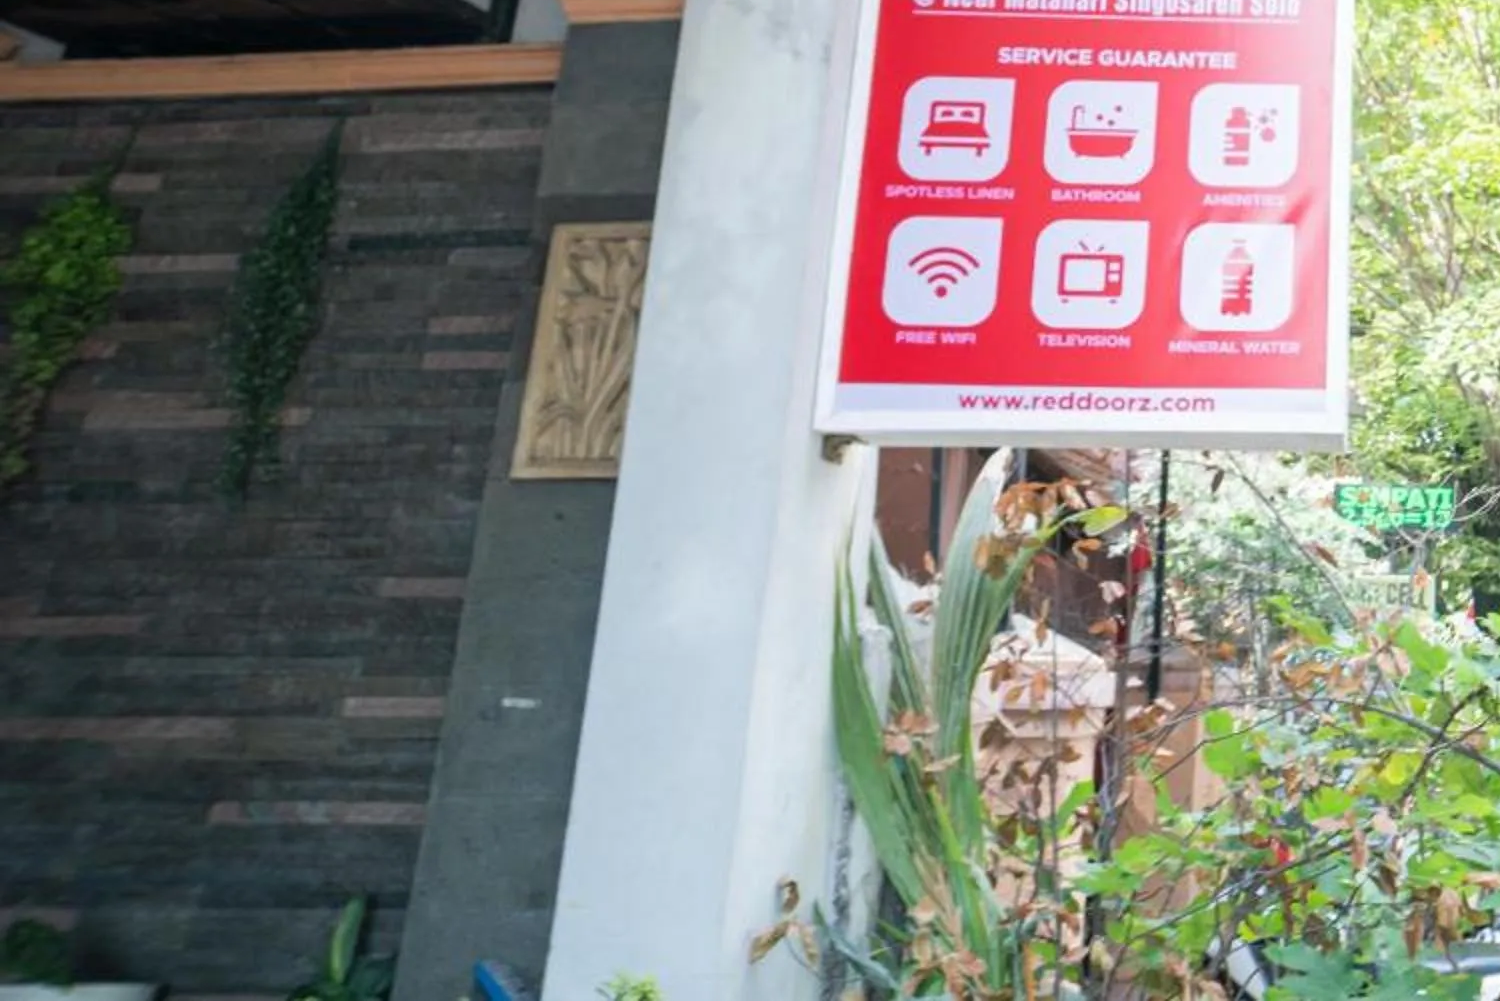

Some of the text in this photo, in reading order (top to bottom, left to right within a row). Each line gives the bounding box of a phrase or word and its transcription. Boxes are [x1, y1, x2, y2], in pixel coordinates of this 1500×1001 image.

[998, 46, 1237, 70] SERVICE GUARANTEE
[885, 184, 1016, 201] SPOTLESS LINEN
[1051, 188, 1142, 203] BATHROOM
[1202, 192, 1286, 208] AMENITIES
[895, 331, 976, 345] FREE WIFI
[1038, 332, 1131, 349] TELEVISION
[1168, 338, 1301, 356] MINERAL WATER
[958, 388, 1215, 412] www.reddoorz.com
